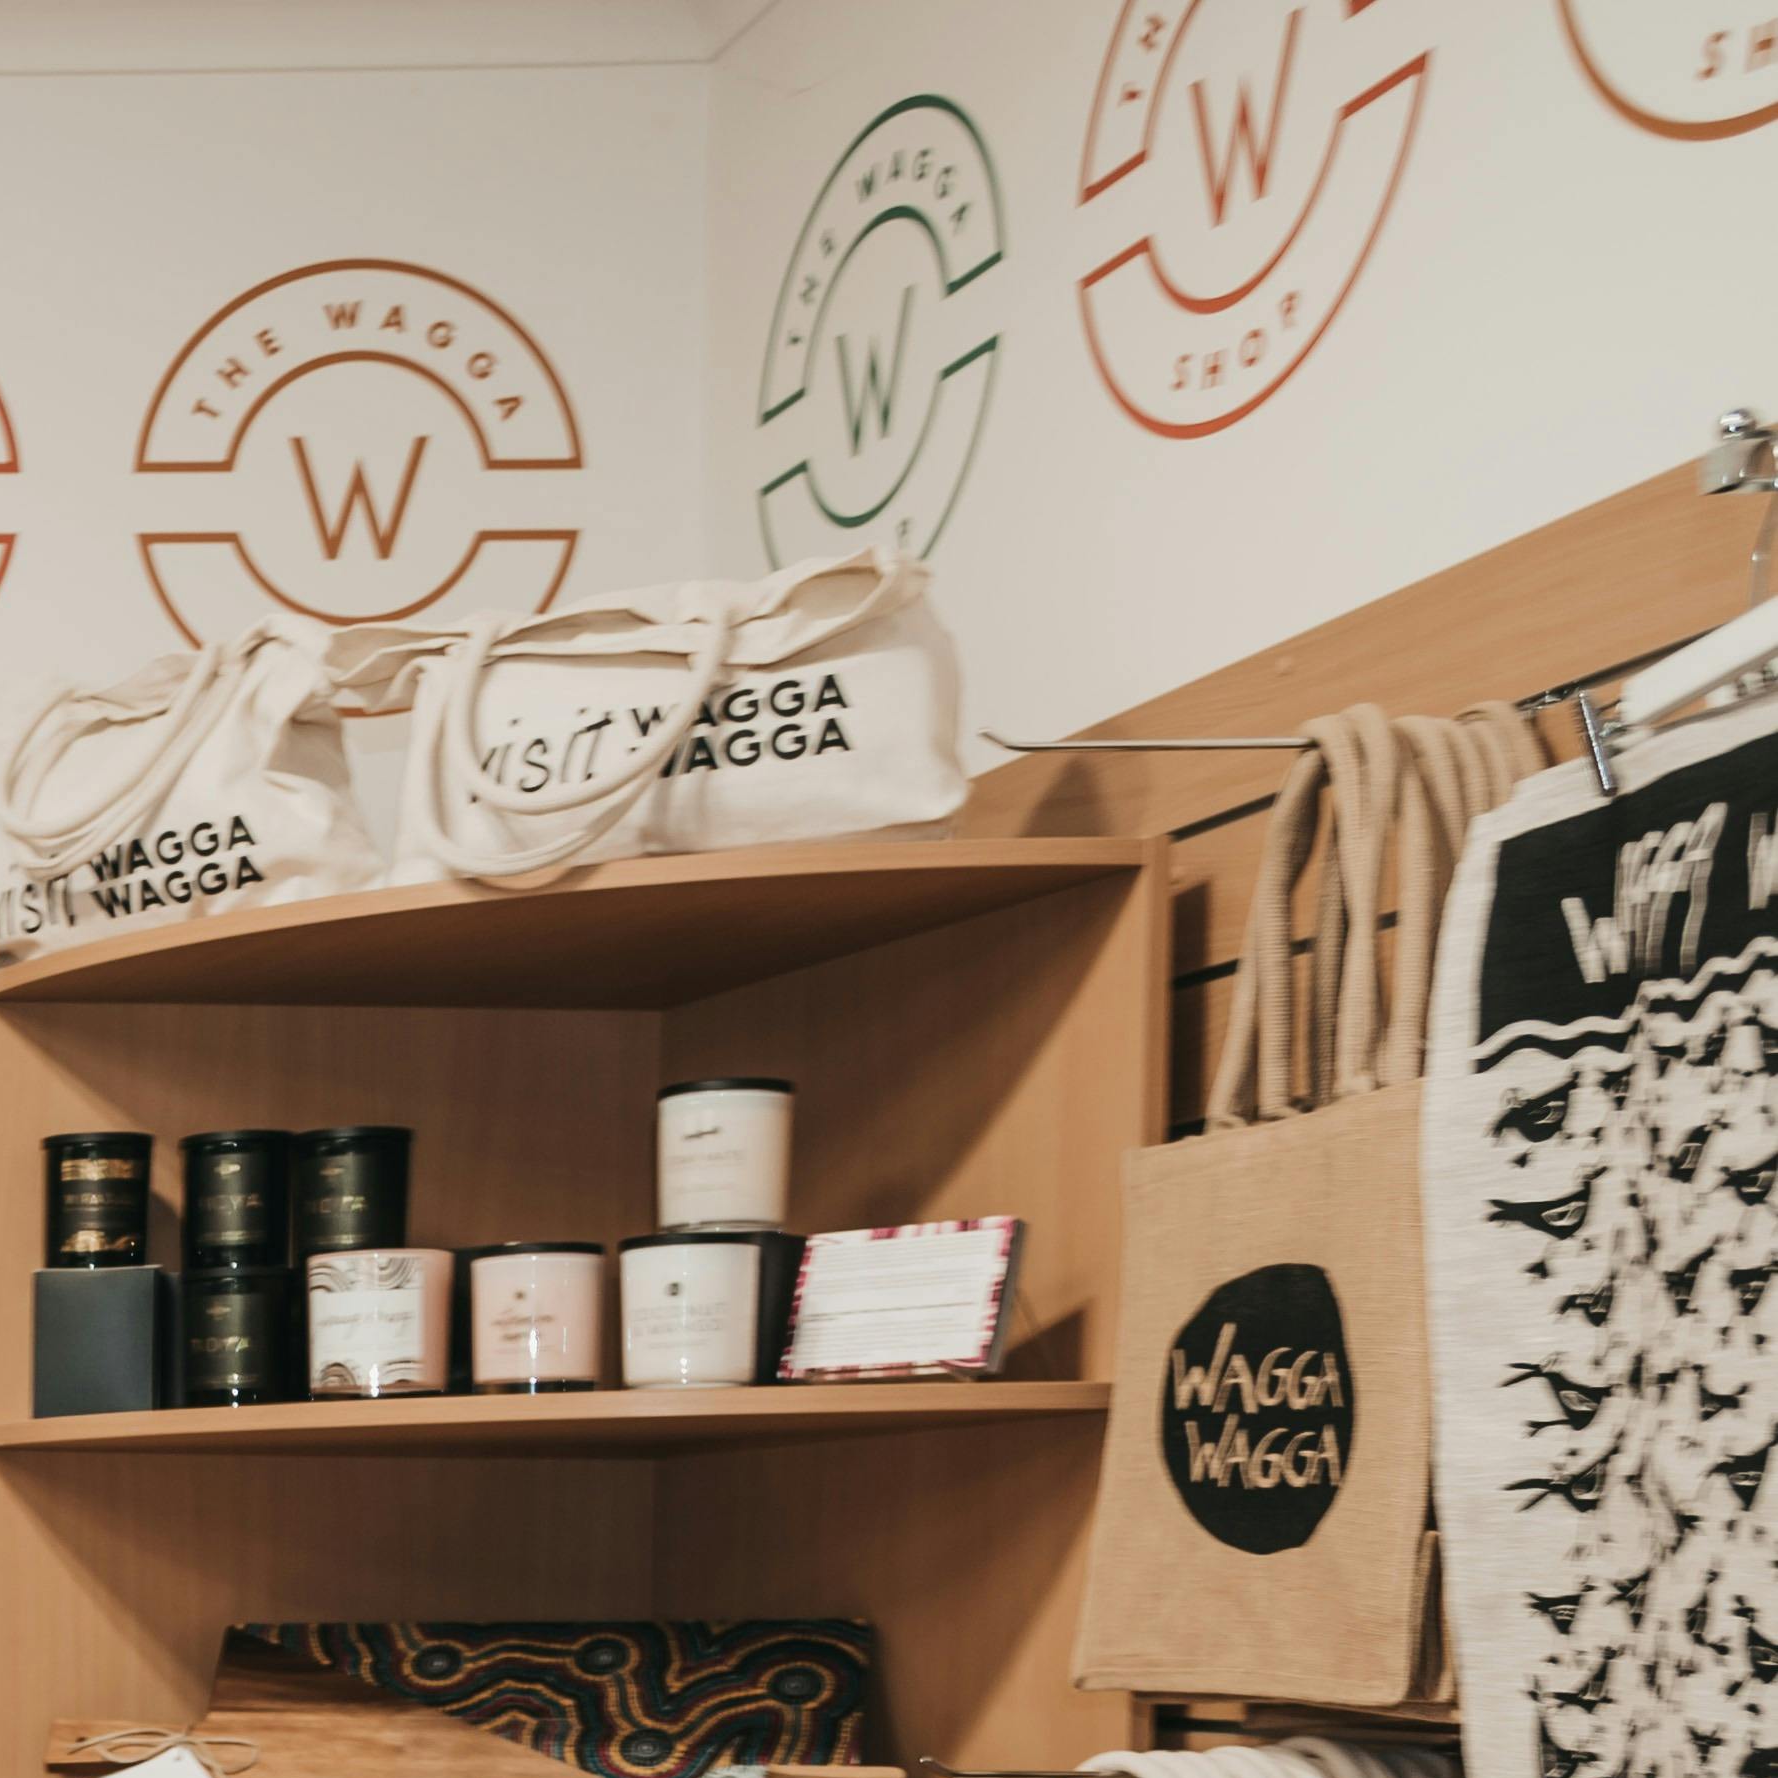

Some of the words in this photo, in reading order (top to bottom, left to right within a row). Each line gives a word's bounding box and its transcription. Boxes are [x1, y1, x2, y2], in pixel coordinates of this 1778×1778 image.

[1188, 6, 1307, 229] W
[188, 325, 285, 423] THE
[320, 297, 527, 425] WAGGA
[834, 282, 919, 459] W
[1171, 289, 1302, 391] SHOP
[287, 433, 432, 563] W
[91, 814, 258, 884] WAGGA
[93, 855, 266, 919] WAGGA
[1172, 1322, 1344, 1414] WAGGA
[1184, 1413, 1343, 1490] WAGGA
